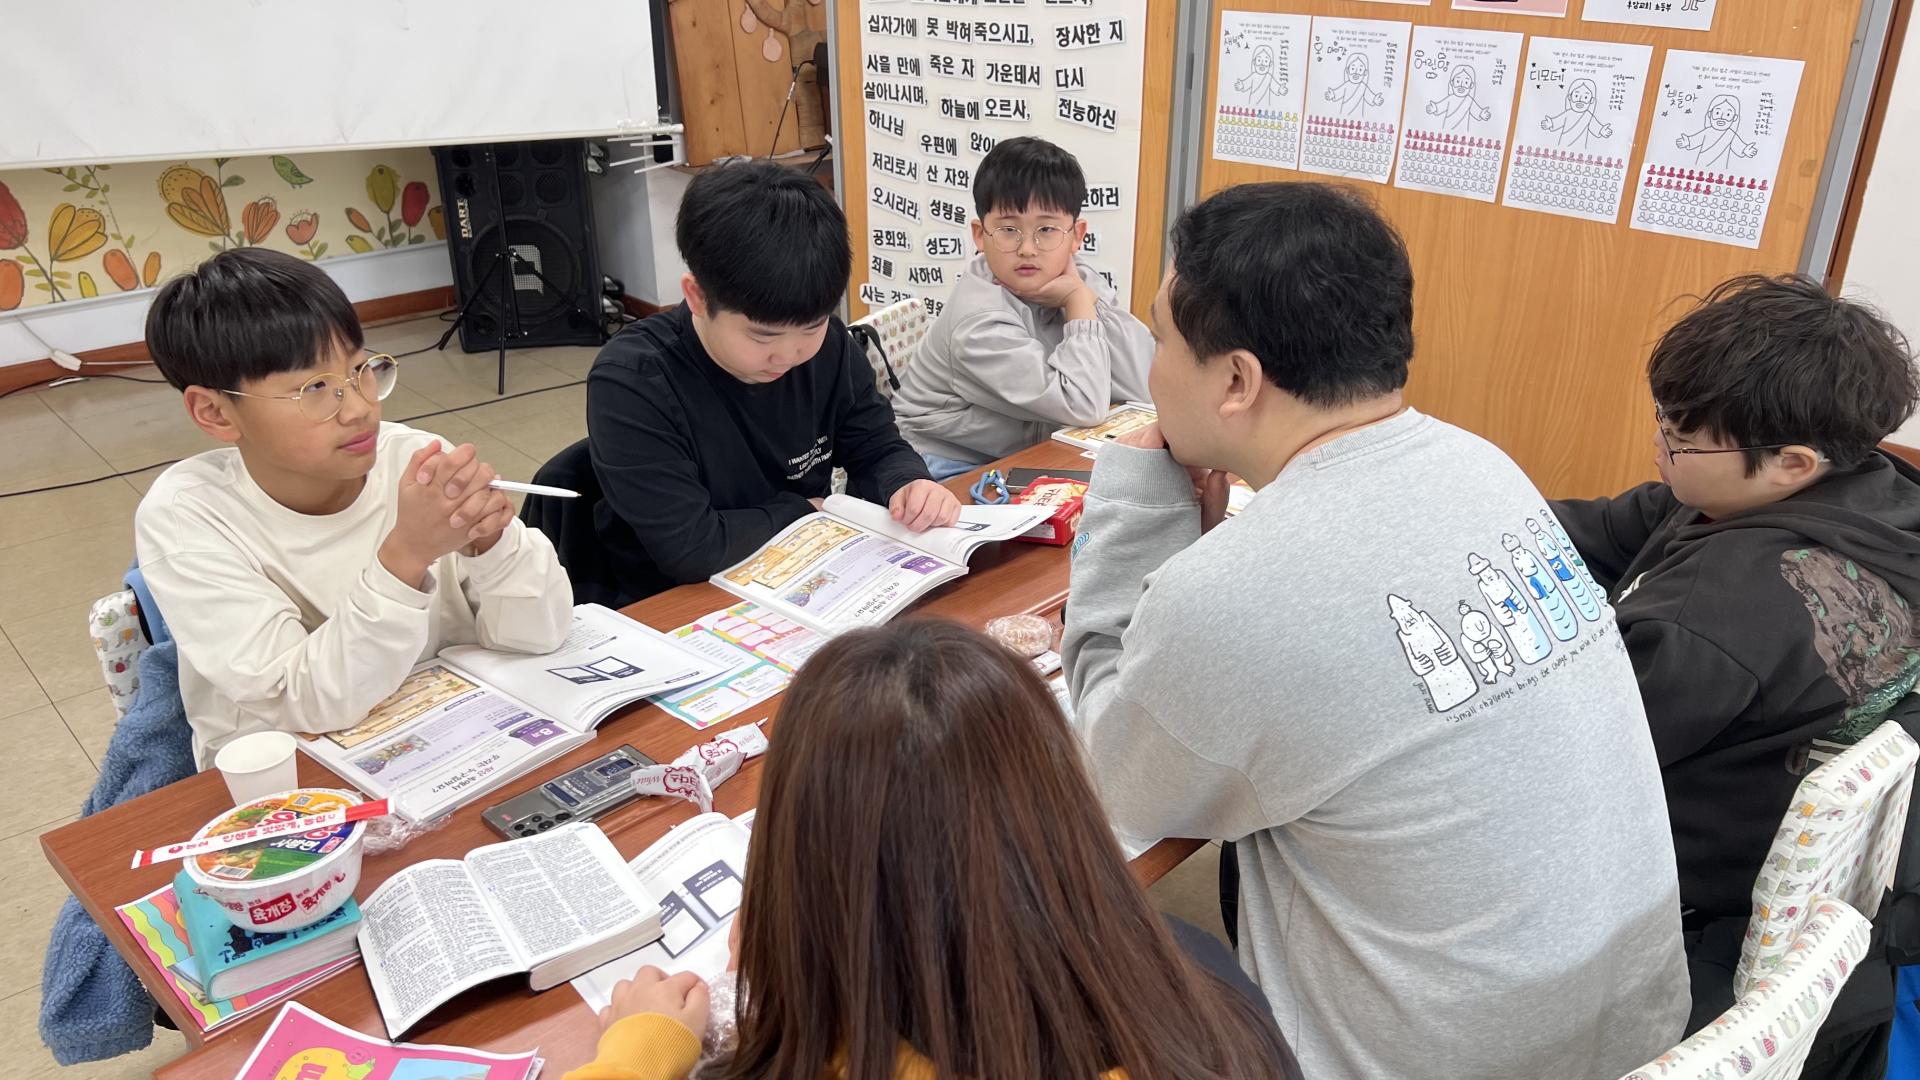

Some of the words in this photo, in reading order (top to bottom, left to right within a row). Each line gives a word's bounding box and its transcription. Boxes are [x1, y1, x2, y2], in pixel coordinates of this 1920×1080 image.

[867, 14, 917, 37] 십자가에
[926, 17, 939, 37] 못
[946, 20, 972, 42] 박혀
[974, 22, 1034, 45] 죽으시고,
[1055, 23, 1101, 48] 장사한
[1109, 20, 1124, 42] 지
[866, 54, 891, 73] 사흘
[897, 57, 921, 77] 만에
[929, 54, 955, 75] 죽은
[961, 58, 975, 78] 자
[985, 62, 1041, 86] 가운데서
[1055, 67, 1085, 88] 다시
[1414, 58, 1450, 72] 어린양
[1529, 69, 1565, 82] 디모데
[864, 82, 928, 105] 살아나시며,
[941, 98, 980, 120] 하늘에
[984, 98, 1031, 120] 오르사,
[1058, 98, 1117, 130] 전능하신
[868, 109, 905, 137] 하나님
[920, 134, 958, 156] 우편에
[872, 152, 918, 181] 저리로서
[926, 165, 939, 182] 산
[944, 167, 970, 188] 자와
[457, 198, 473, 239] DART
[872, 187, 921, 222] 오시리라.
[929, 199, 966, 225] 성령을
[872, 229, 912, 249] 공회와,
[926, 237, 963, 256] 성도가
[871, 256, 894, 278] 죄를
[908, 266, 944, 284] 사하여
[861, 285, 885, 304] 사는
[1478, 686, 1515, 711] challenge
[1515, 675, 1540, 694] brings
[222, 829, 258, 843] 인생을
[252, 898, 293, 922] 육개장
